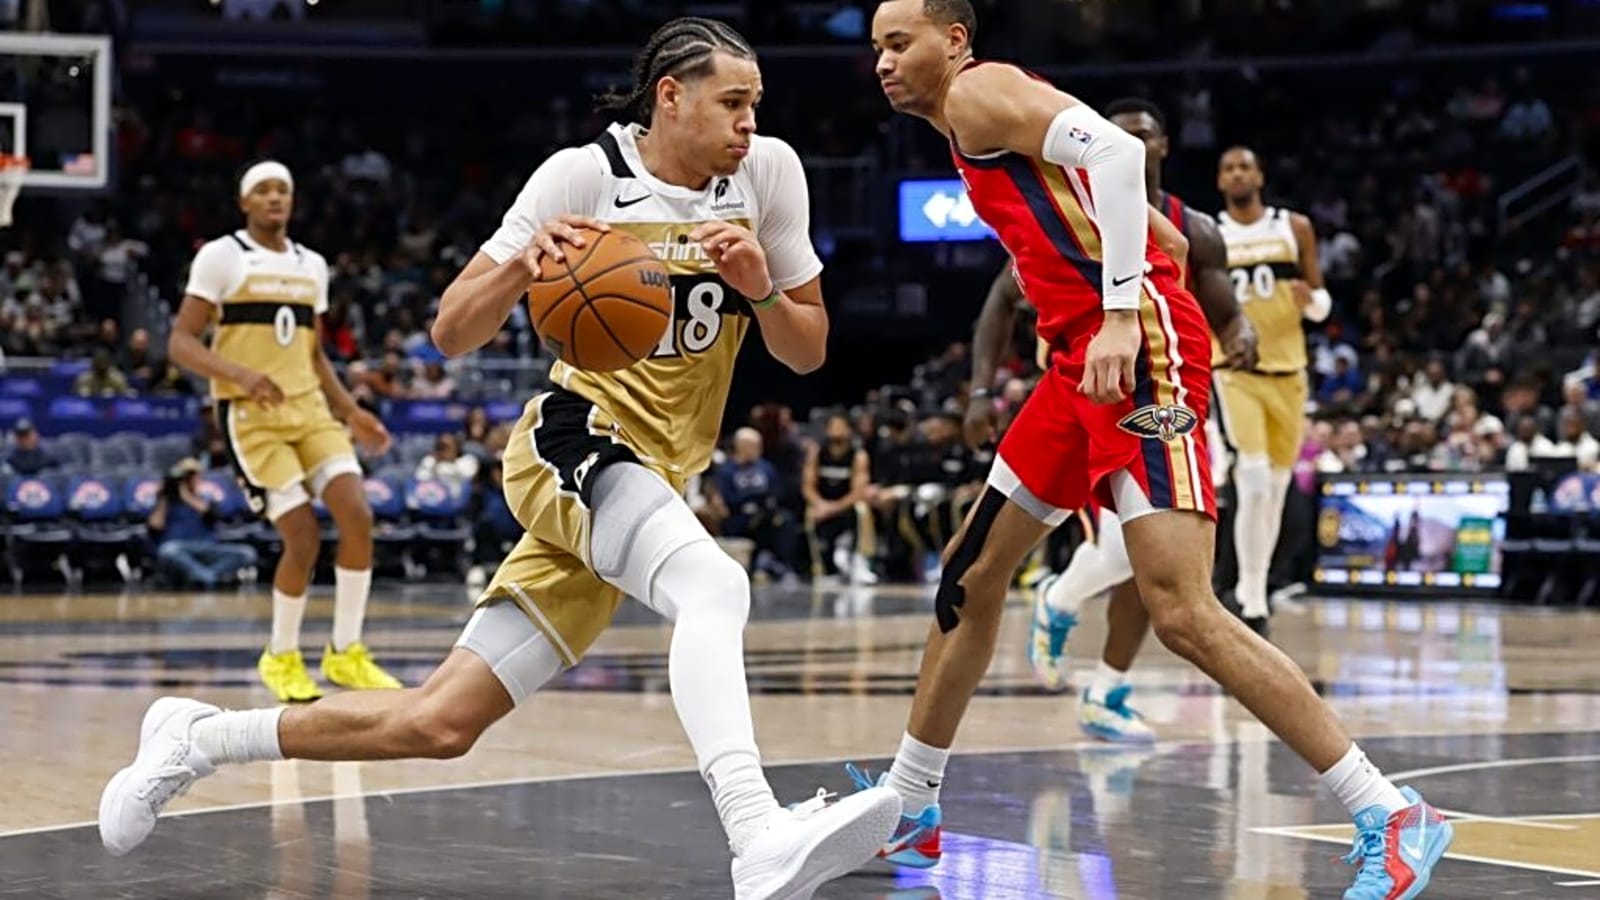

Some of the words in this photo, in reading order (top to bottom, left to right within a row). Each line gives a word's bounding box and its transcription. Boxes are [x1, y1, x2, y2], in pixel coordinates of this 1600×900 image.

[1229, 264, 1276, 303] 20
[274, 305, 296, 347] 0
[650, 281, 725, 356] 18
